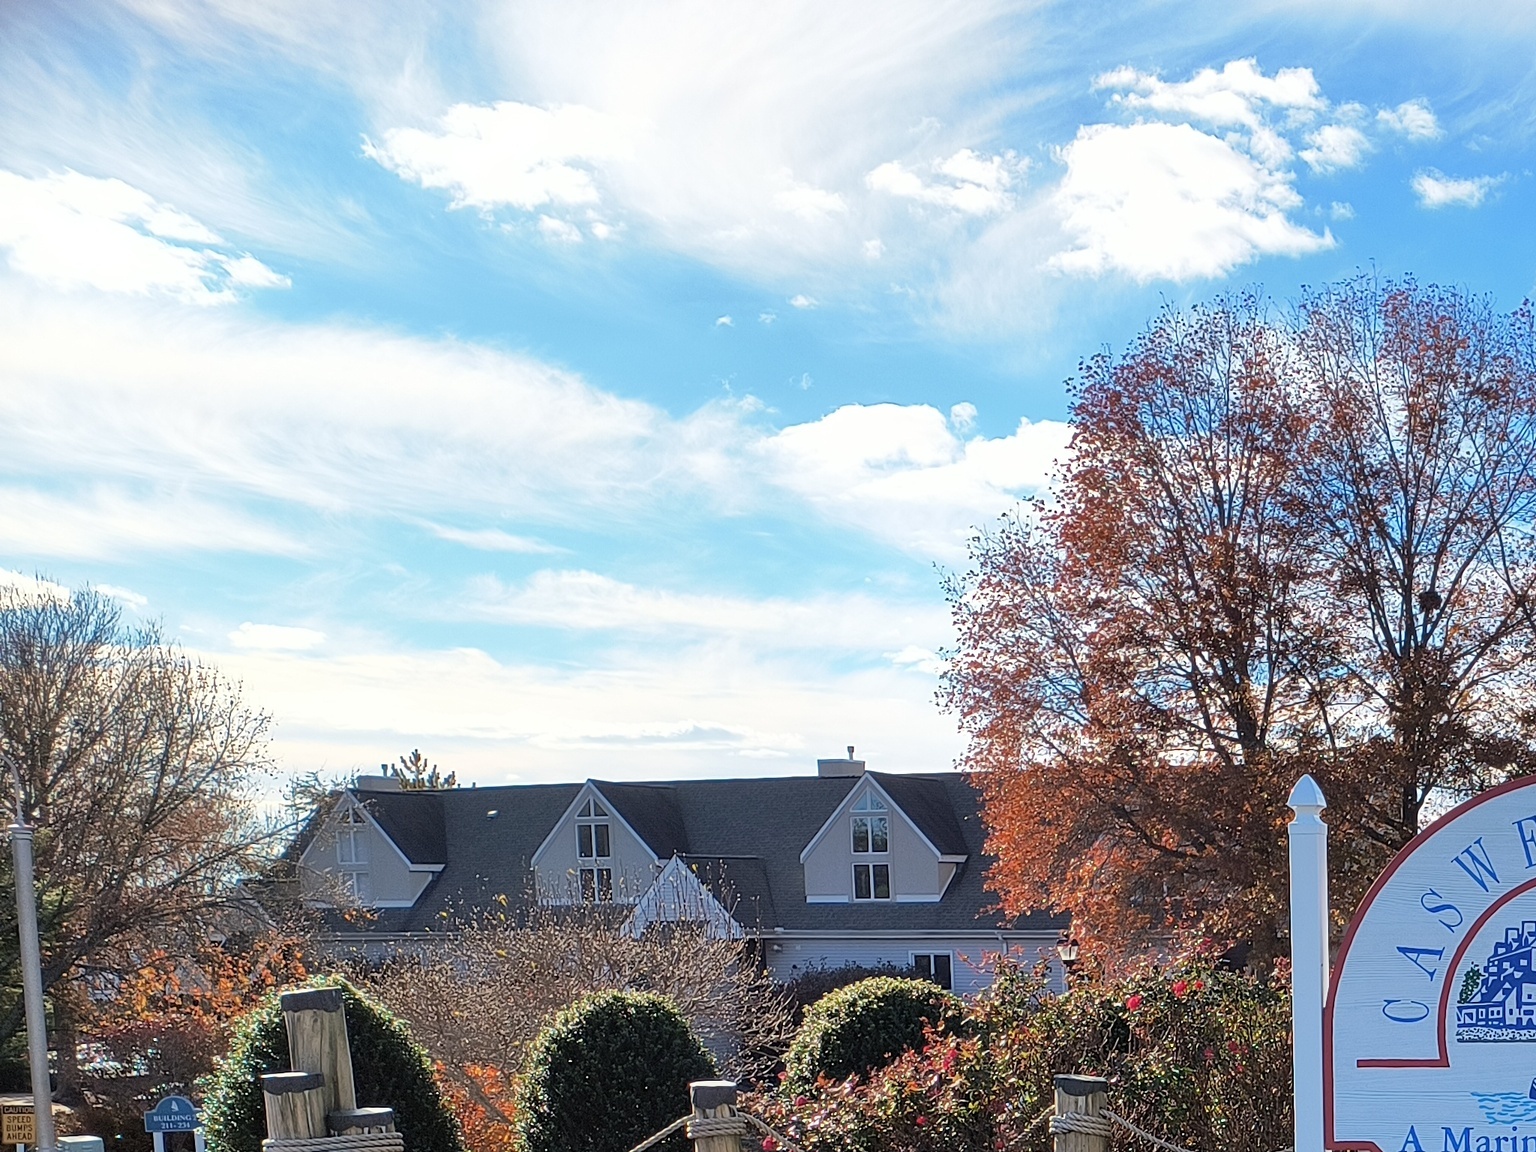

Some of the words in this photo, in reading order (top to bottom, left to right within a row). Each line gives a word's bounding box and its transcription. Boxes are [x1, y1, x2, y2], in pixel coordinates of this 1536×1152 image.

[6, 1115, 32, 1123] SPEED
[153, 1114, 192, 1122] BUILDING
[6, 1124, 33, 1132] BUMPS
[6, 1132, 33, 1140] AHEAD
